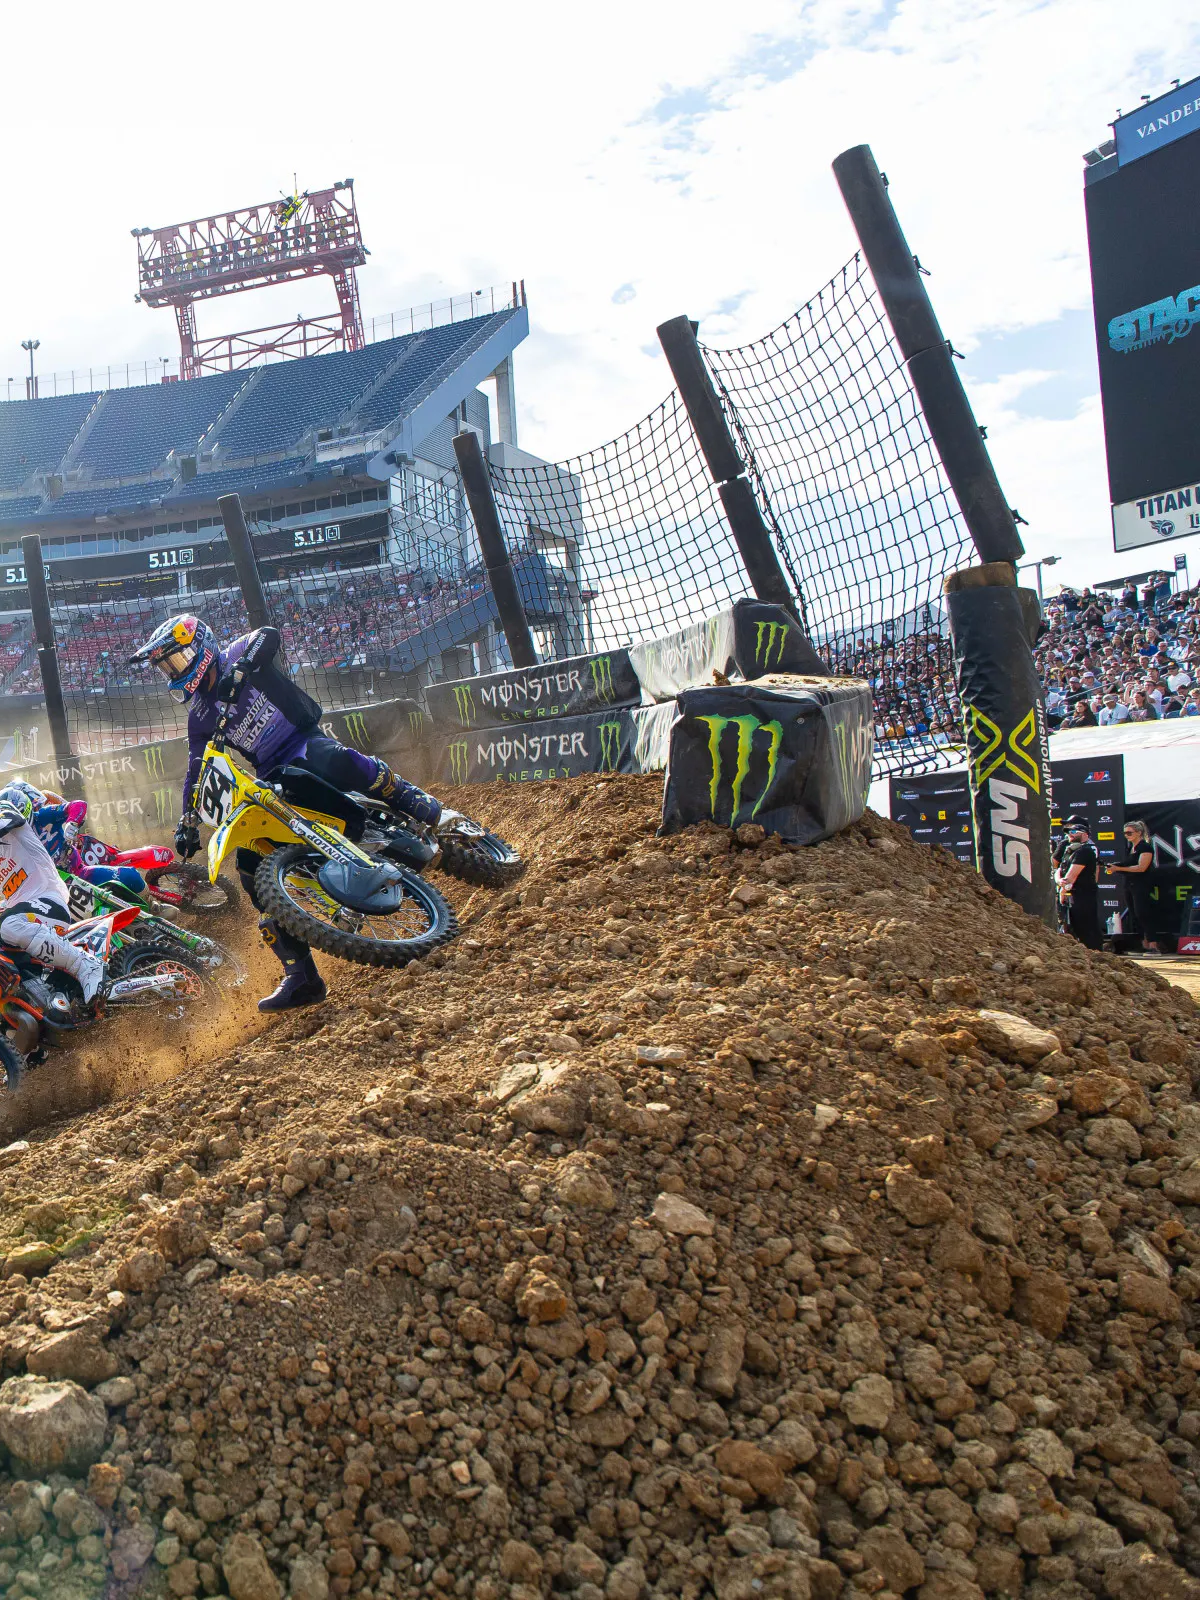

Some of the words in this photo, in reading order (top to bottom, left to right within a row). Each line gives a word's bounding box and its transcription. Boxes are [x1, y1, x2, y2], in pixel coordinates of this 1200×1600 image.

[6, 567, 26, 583] 5.1
[480, 668, 583, 709] MONSTER
[232, 691, 268, 746] PROGRESSIVE
[243, 705, 276, 750] SUZUKI
[501, 702, 570, 723] ENERGY
[477, 731, 589, 767] MONSTER
[496, 766, 571, 783] ENERGY
[306, 829, 350, 866] DUNLOP
[2, 868, 28, 900] KTM
